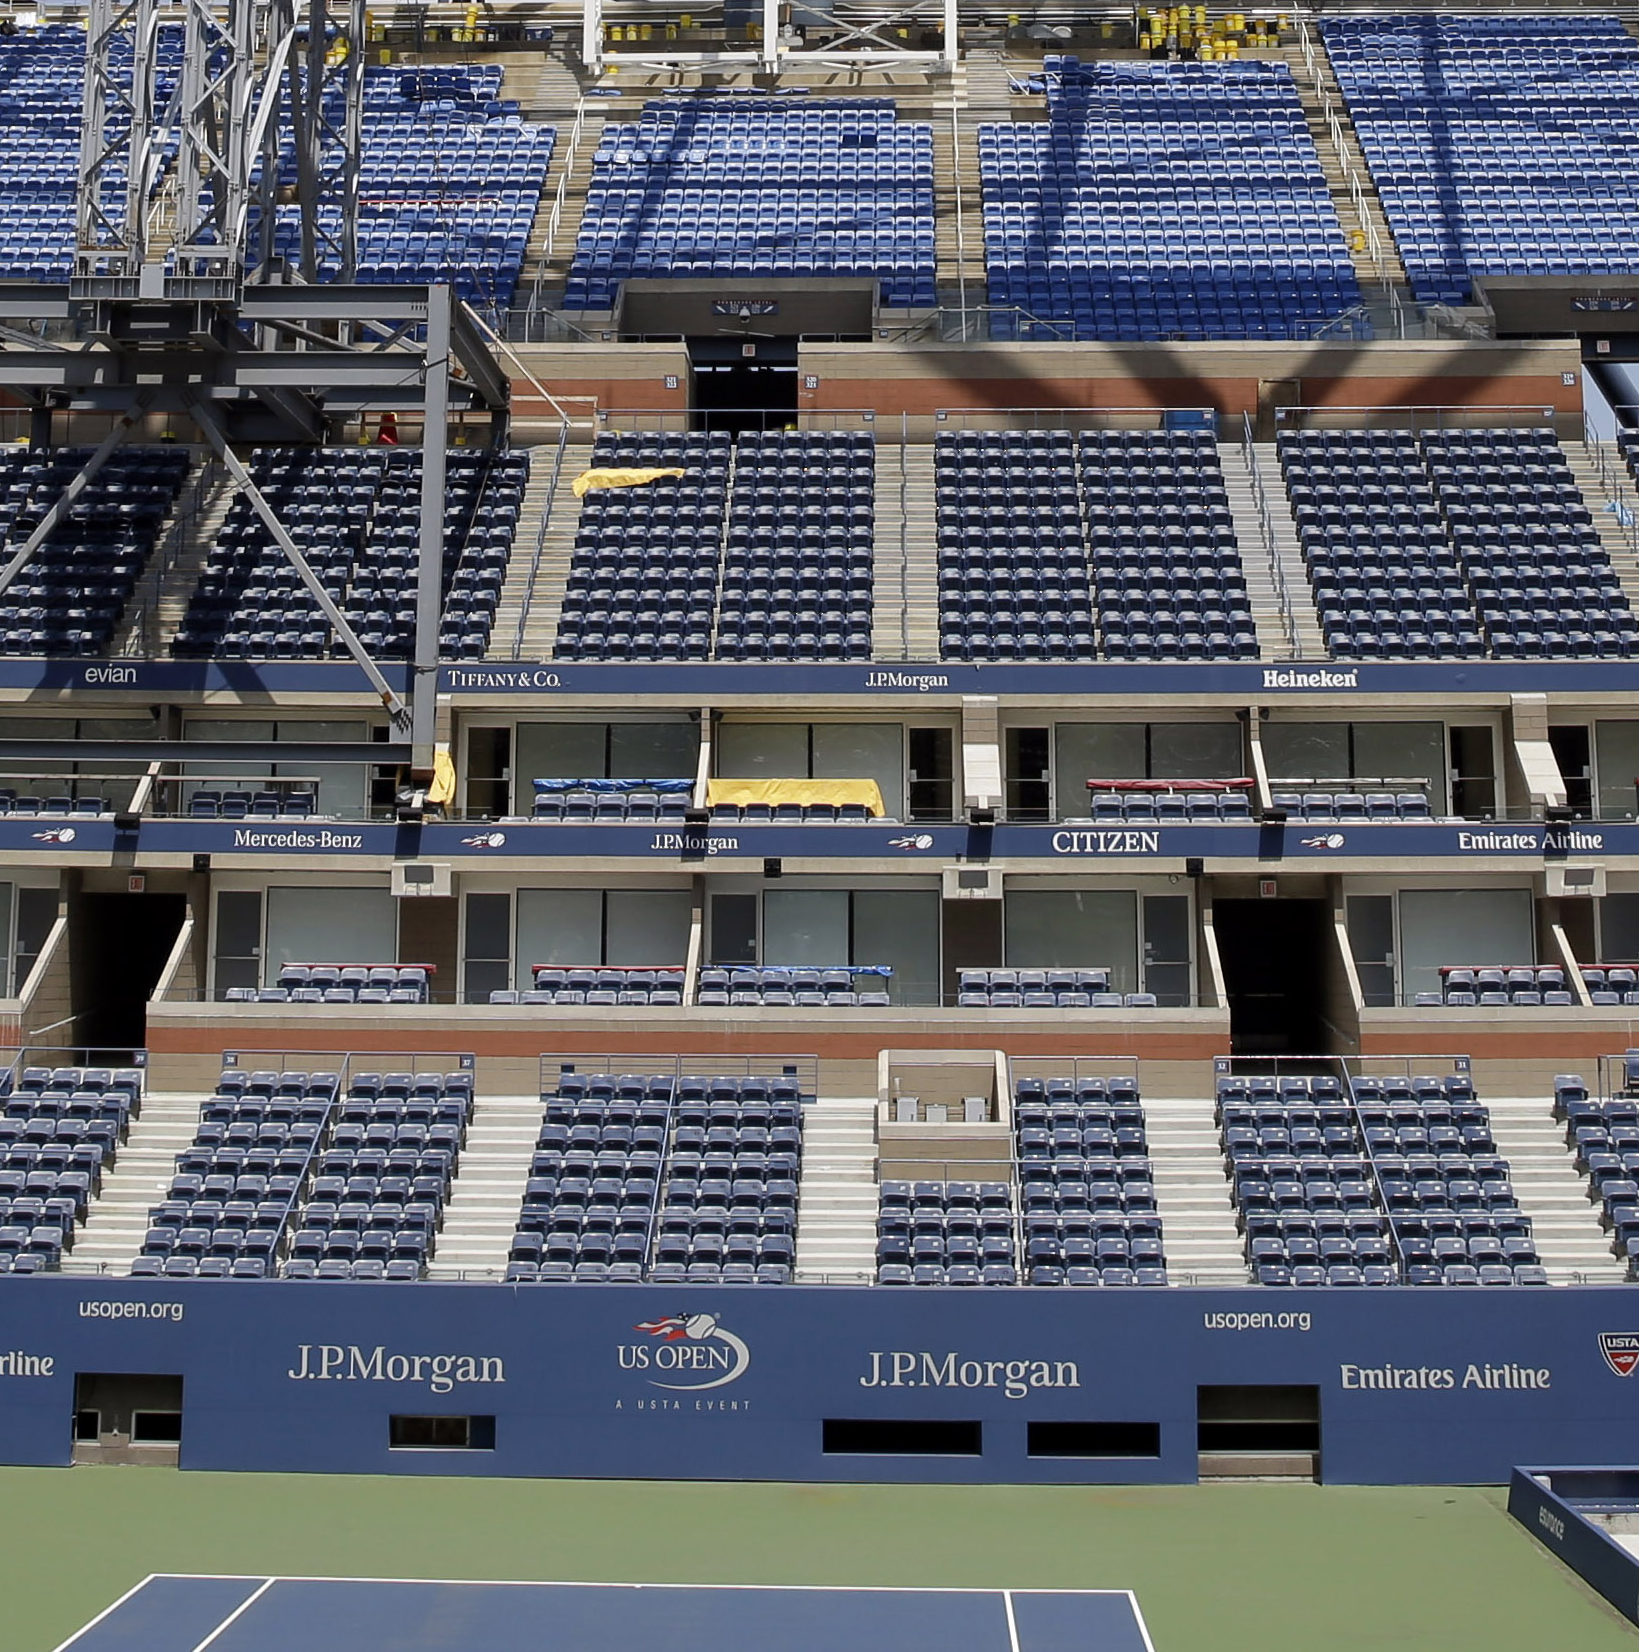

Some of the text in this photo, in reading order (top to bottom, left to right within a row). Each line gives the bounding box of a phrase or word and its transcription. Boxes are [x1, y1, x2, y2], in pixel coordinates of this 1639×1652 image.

[85, 664, 137, 684] evian
[865, 672, 948, 691] J.P.Morgan
[1263, 669, 1357, 688] Heineken
[234, 829, 362, 849] Mercedes-Benz
[650, 834, 739, 854] J.P.Morgan
[1052, 831, 1159, 853] CITIZEN
[1458, 831, 1603, 851] Emirates Airline
[79, 1299, 184, 1321] usopen.org
[1204, 1310, 1311, 1332] usopen.org
[1606, 1336, 1639, 1349] USTA
[617, 1345, 730, 1369] US OPEN
[289, 1345, 505, 1393] J.P.Morgan
[860, 1352, 1080, 1399] J.P.Morgan
[1340, 1363, 1551, 1390] Emirates Airline
[615, 1400, 750, 1411] A USTA EVENT
